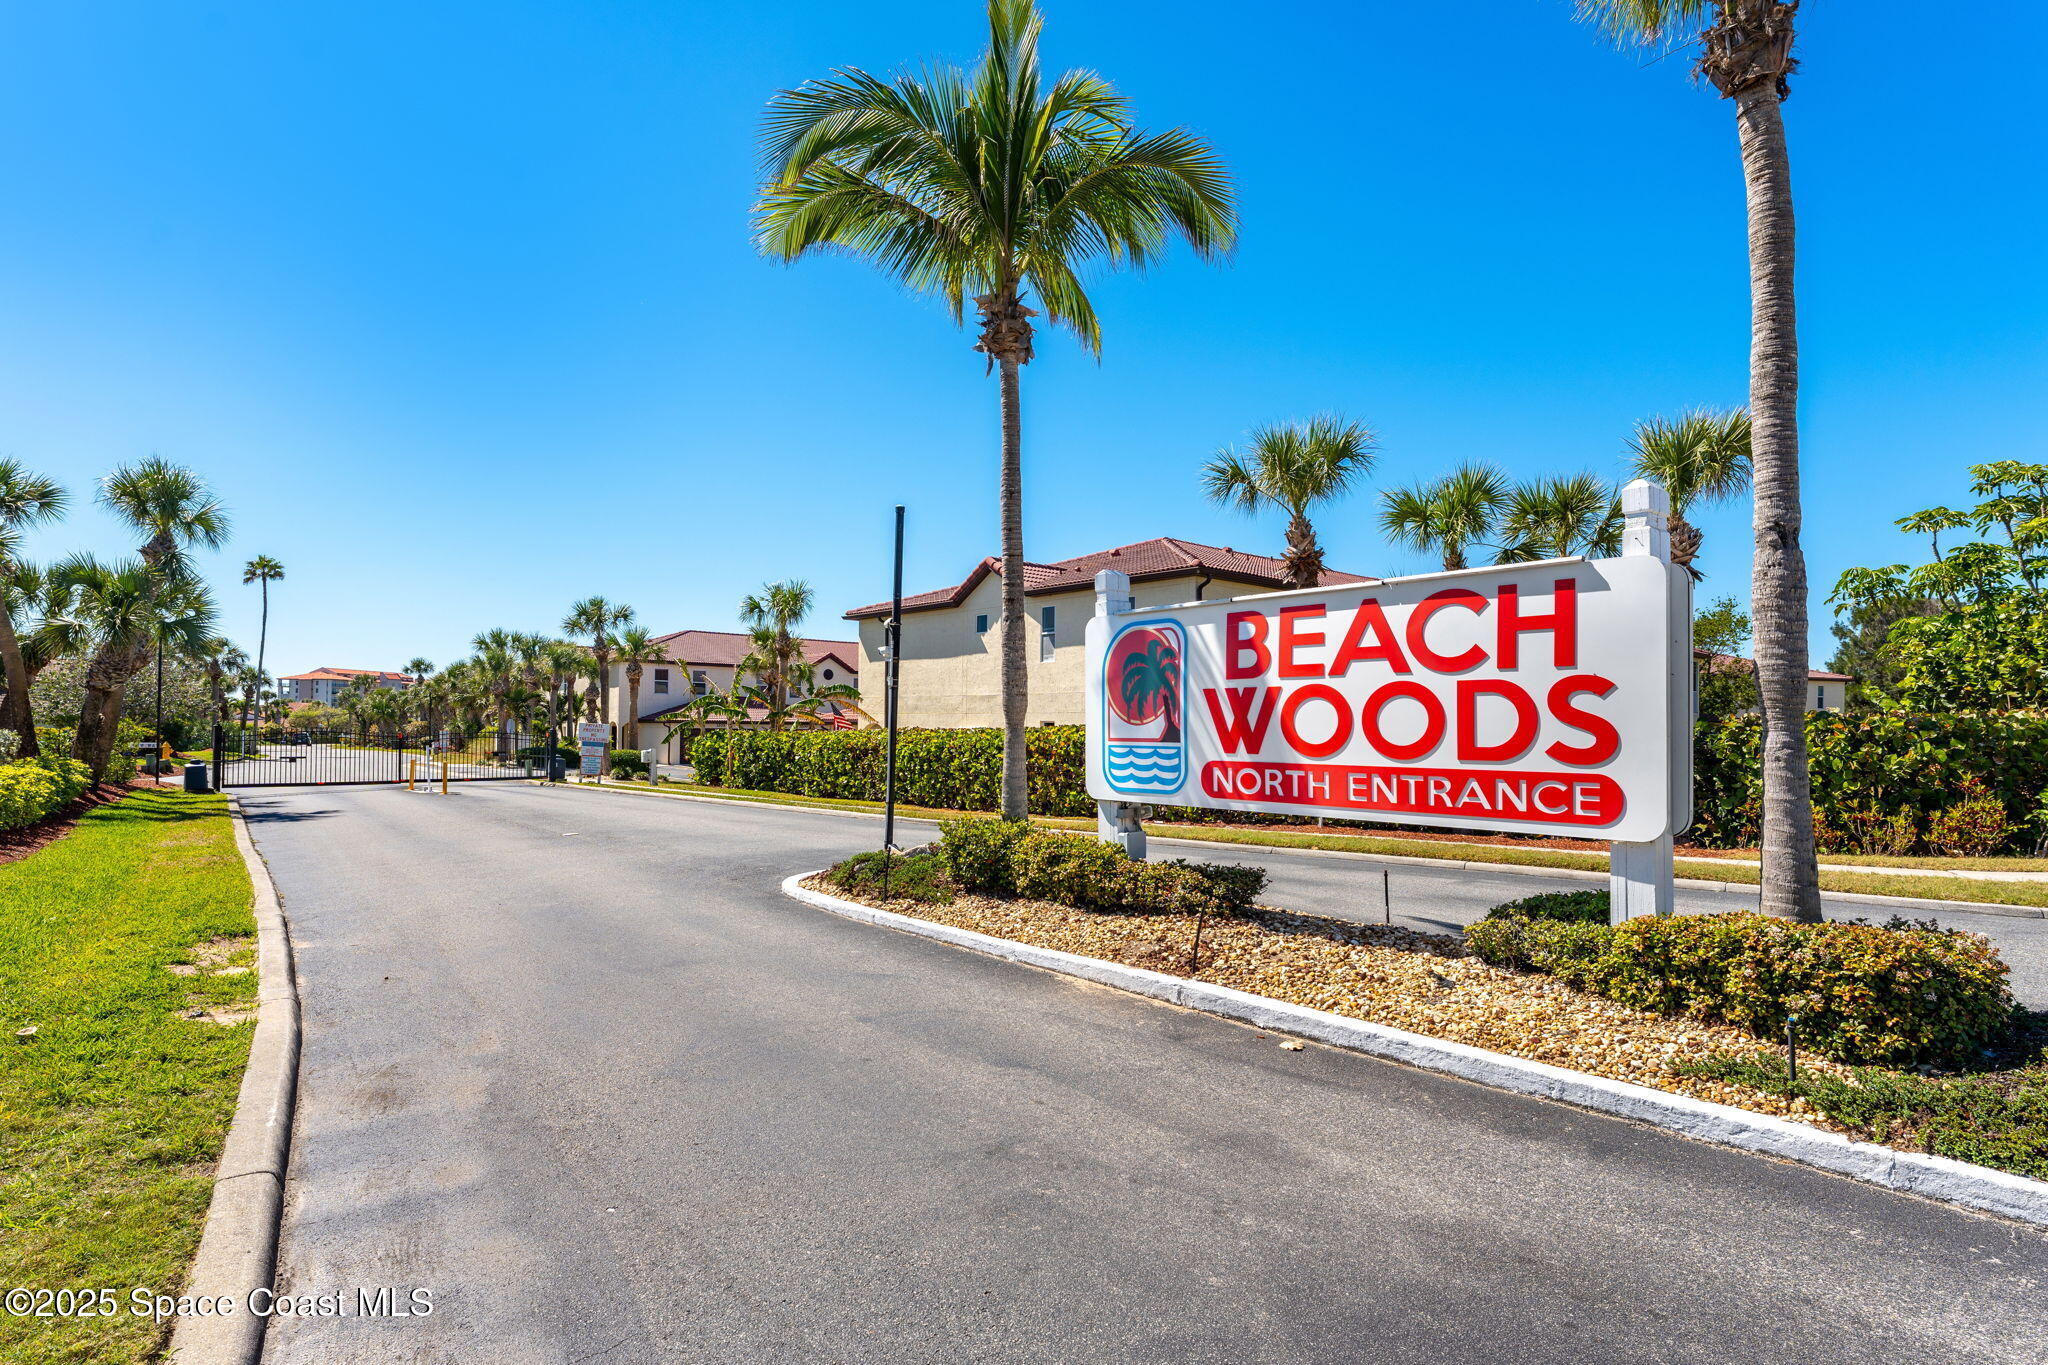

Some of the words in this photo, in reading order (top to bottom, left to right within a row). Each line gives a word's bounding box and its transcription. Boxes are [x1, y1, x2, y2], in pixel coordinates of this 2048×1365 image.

[1226, 578, 1577, 681] BEACH
[1203, 674, 1620, 767] WOODS
[1212, 766, 1331, 800] NORTH
[1347, 773, 1602, 817] ENTRANCE
